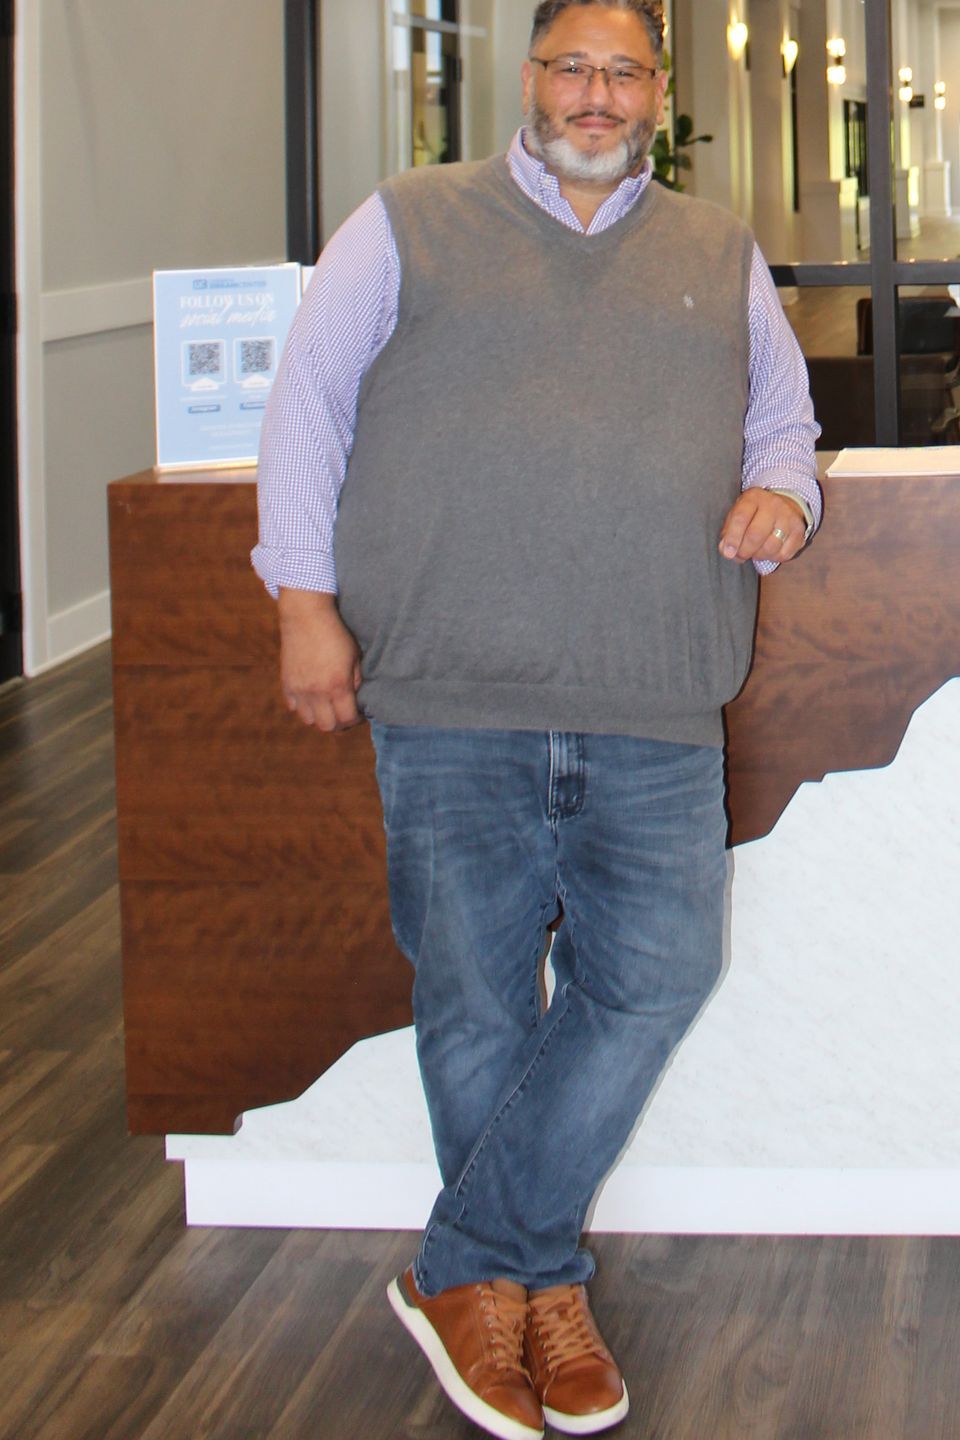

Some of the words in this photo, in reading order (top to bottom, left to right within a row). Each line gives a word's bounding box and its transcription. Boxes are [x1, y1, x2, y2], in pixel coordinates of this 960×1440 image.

[180, 295, 234, 308] FOLLOW
[237, 293, 254, 305] US
[255, 292, 275, 305] ON
